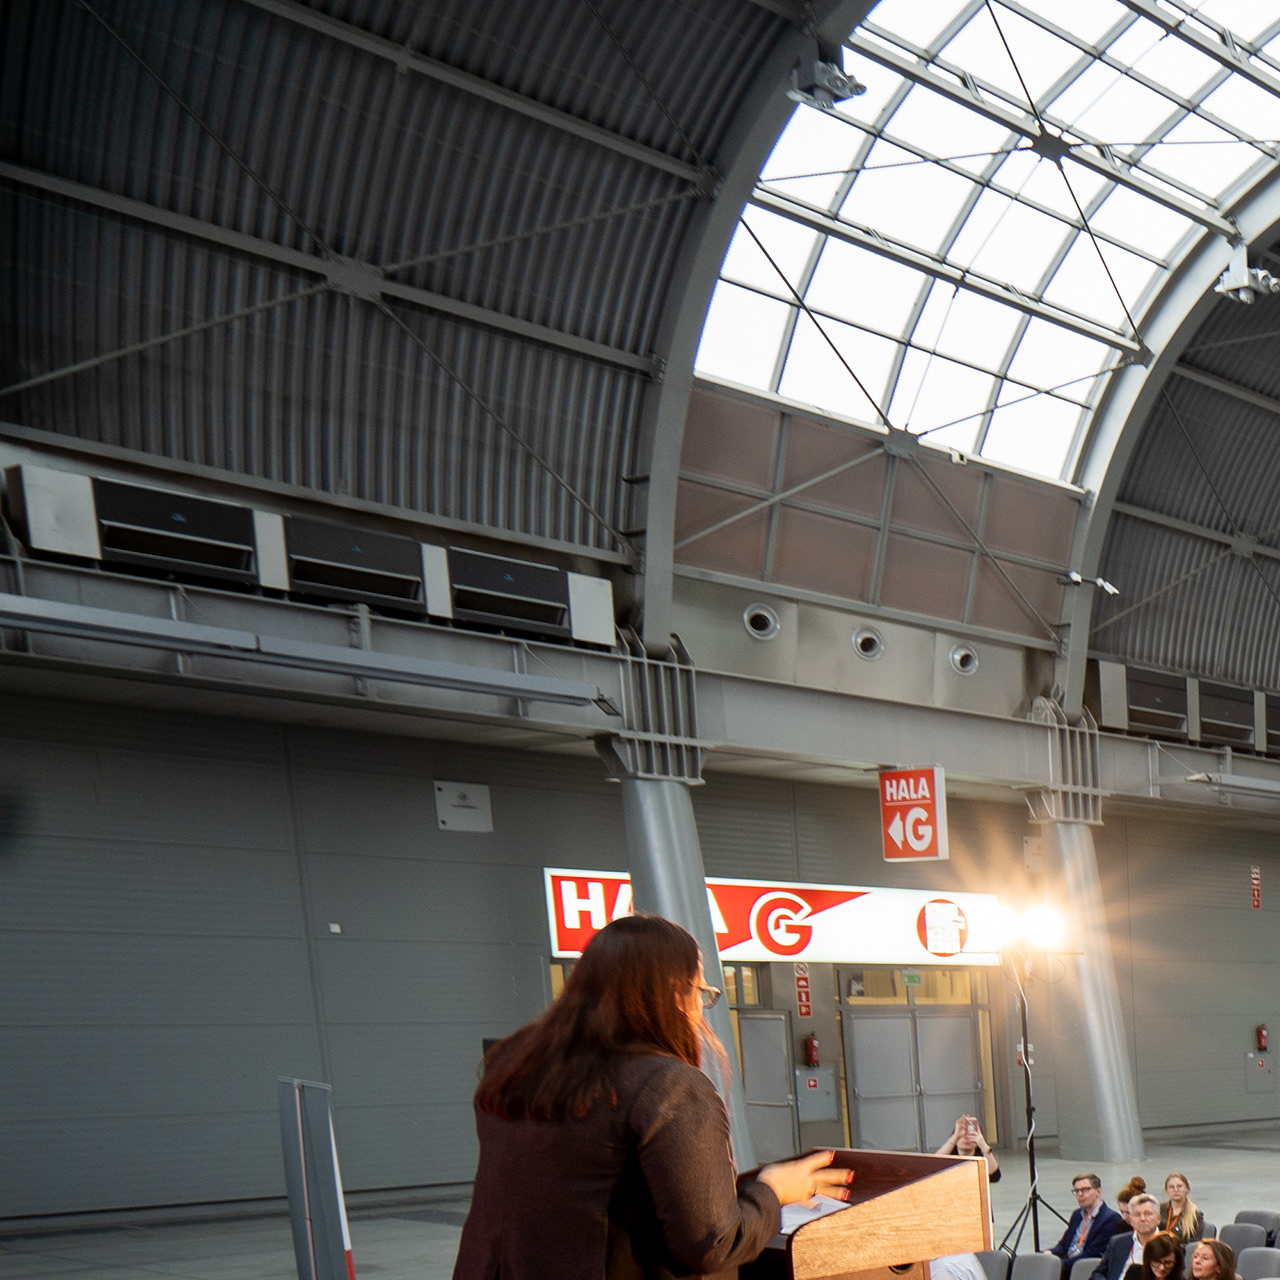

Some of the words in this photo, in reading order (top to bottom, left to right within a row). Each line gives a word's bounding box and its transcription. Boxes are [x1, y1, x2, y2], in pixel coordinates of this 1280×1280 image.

[885, 777, 931, 801] HALA
[905, 806, 933, 852] G
[751, 892, 813, 956] G
